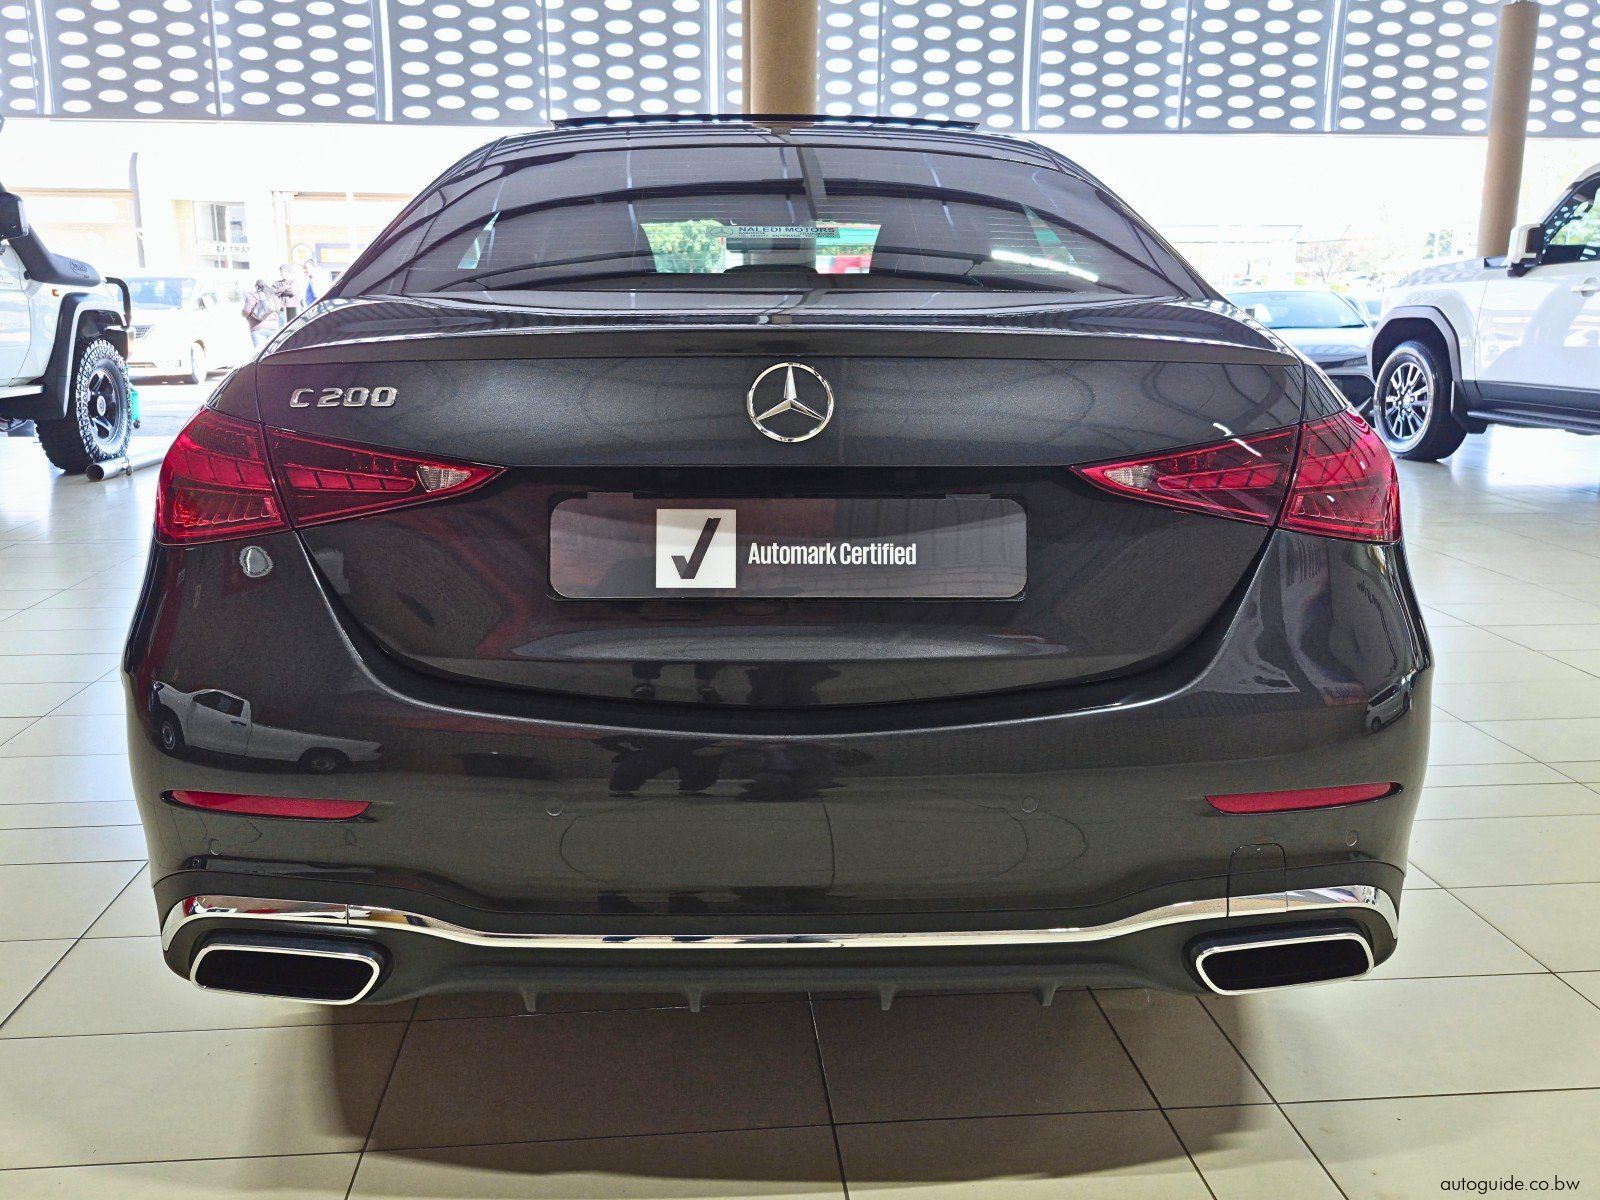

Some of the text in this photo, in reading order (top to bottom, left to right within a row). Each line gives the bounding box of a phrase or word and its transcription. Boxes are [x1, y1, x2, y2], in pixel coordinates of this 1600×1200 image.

[289, 386, 398, 408] C 200
[748, 542, 917, 566] Automark Certified
